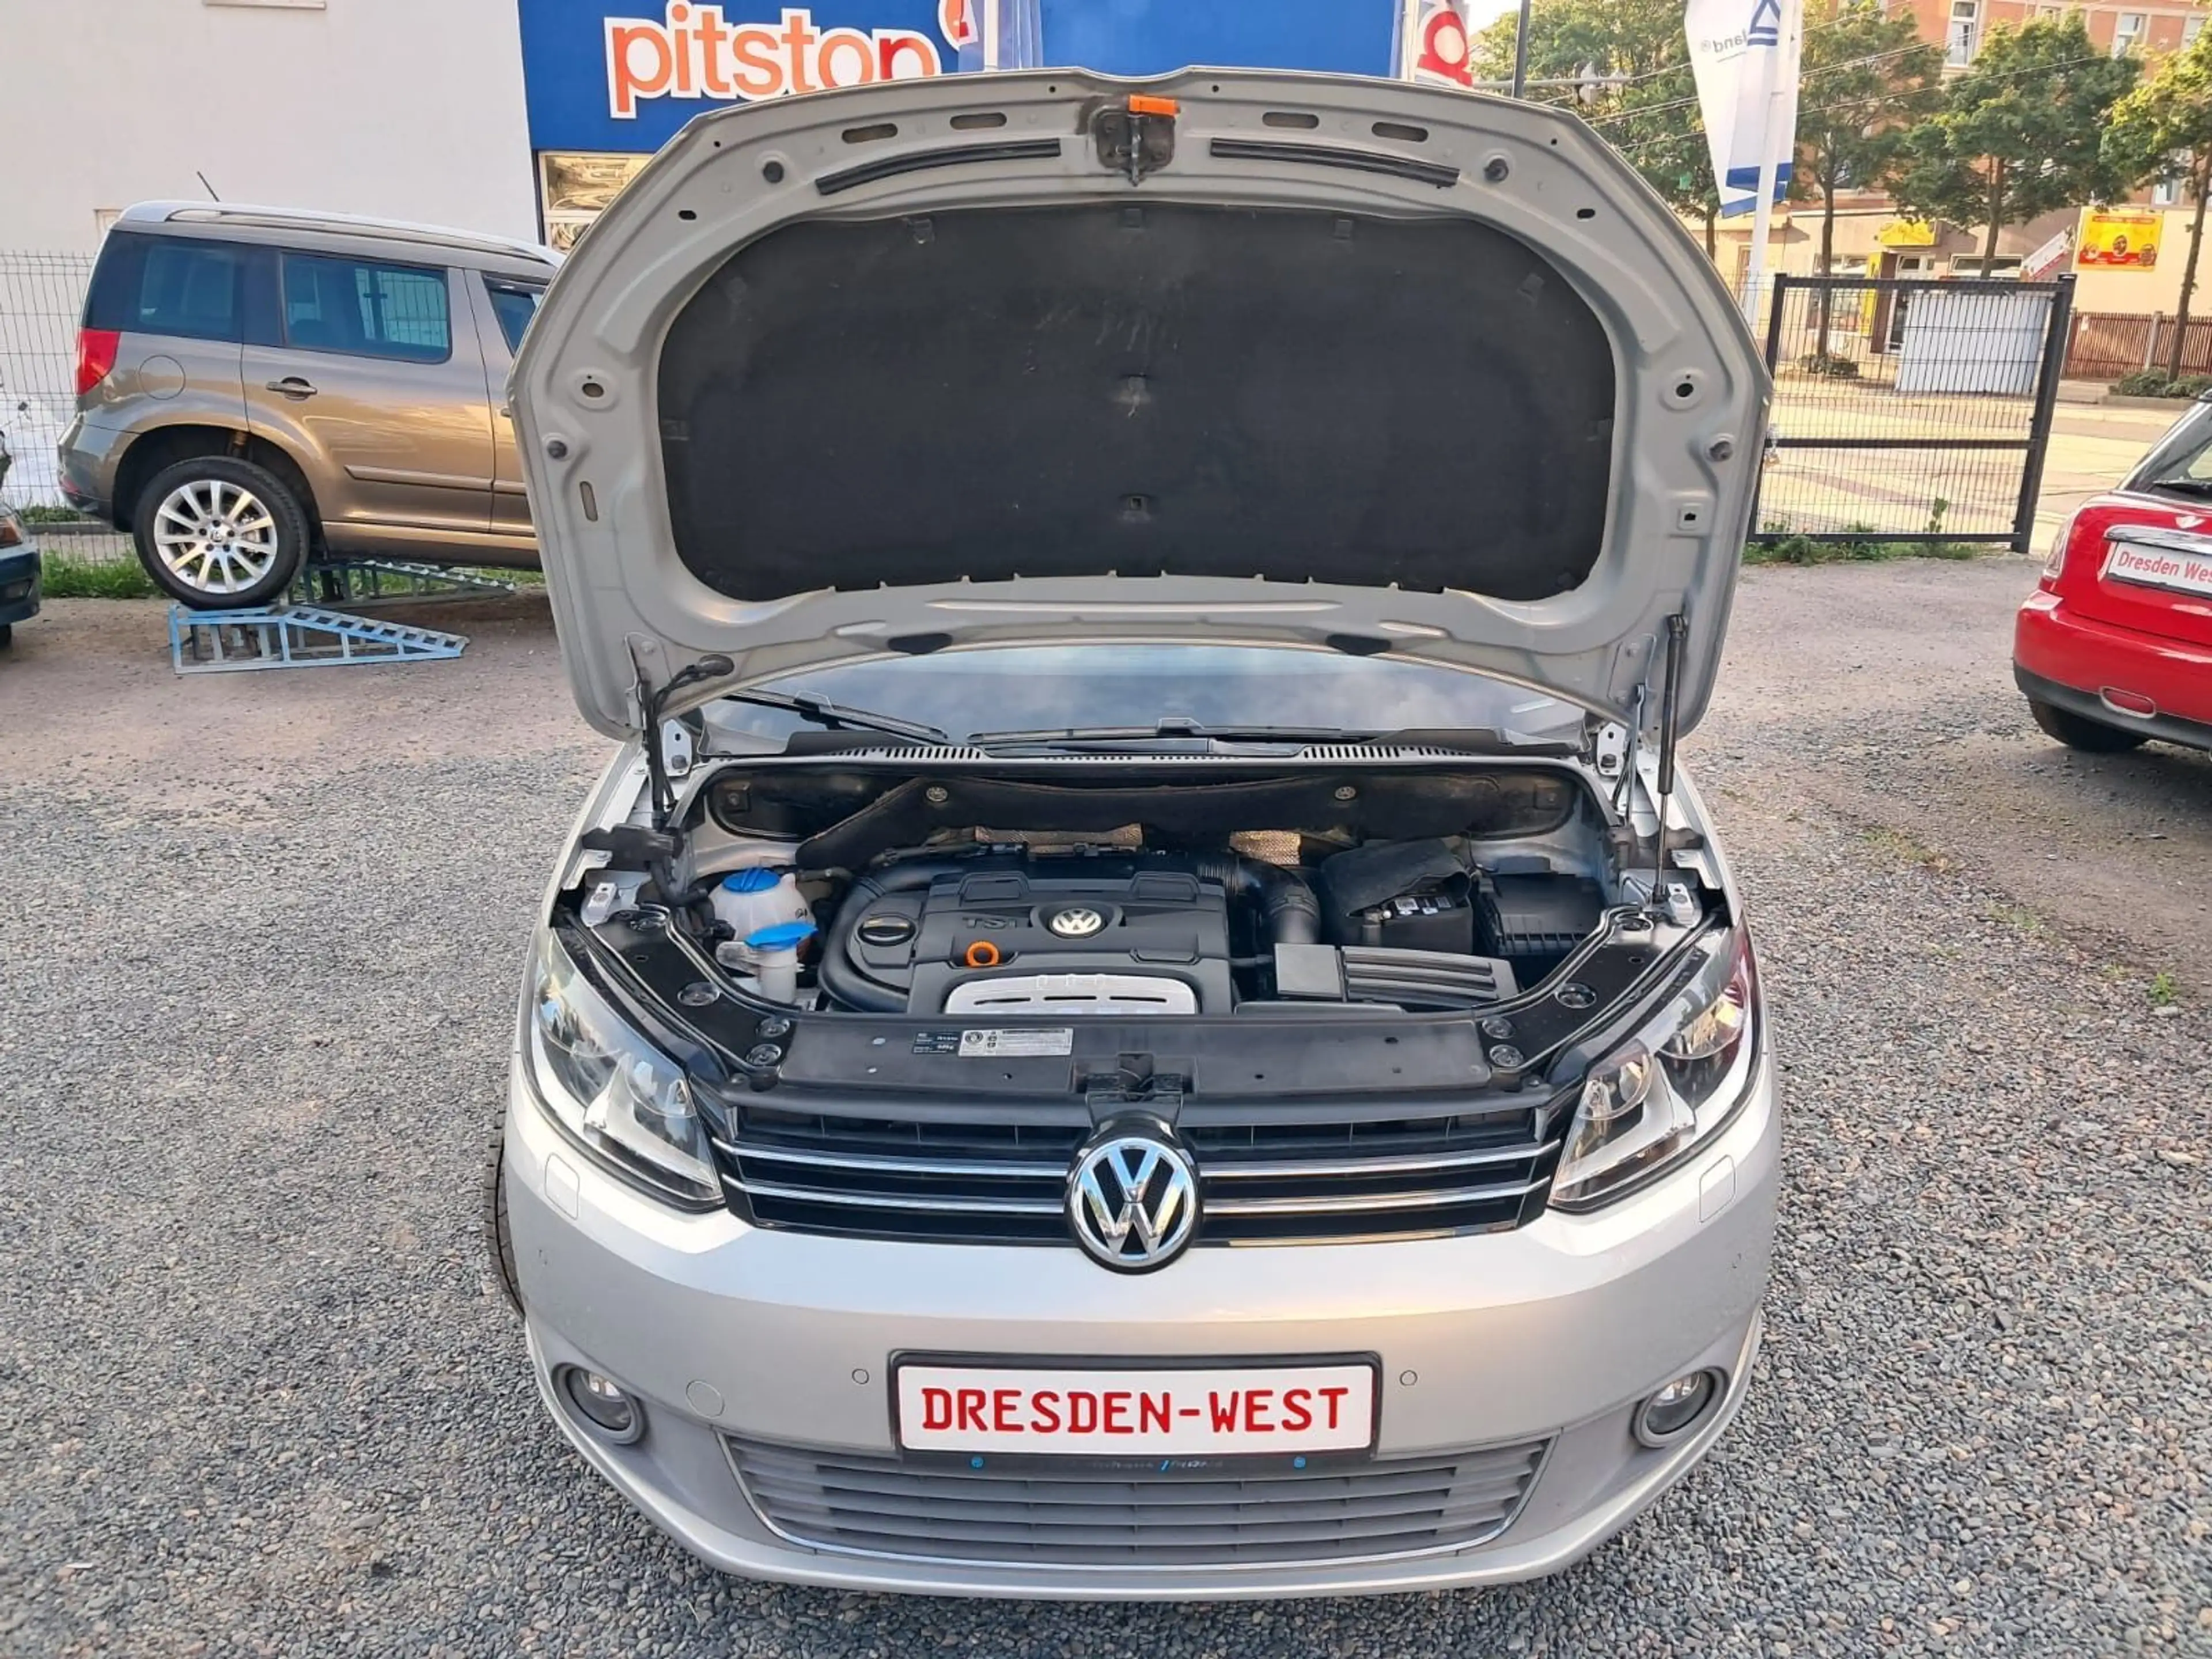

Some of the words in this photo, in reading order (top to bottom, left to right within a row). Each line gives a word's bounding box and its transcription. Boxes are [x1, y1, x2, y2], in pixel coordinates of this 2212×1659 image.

[2118, 551, 2180, 576] Dresden
[1071, 1138, 1196, 1267] VW
[921, 1387, 1350, 1435] DRESDEN-WEST
